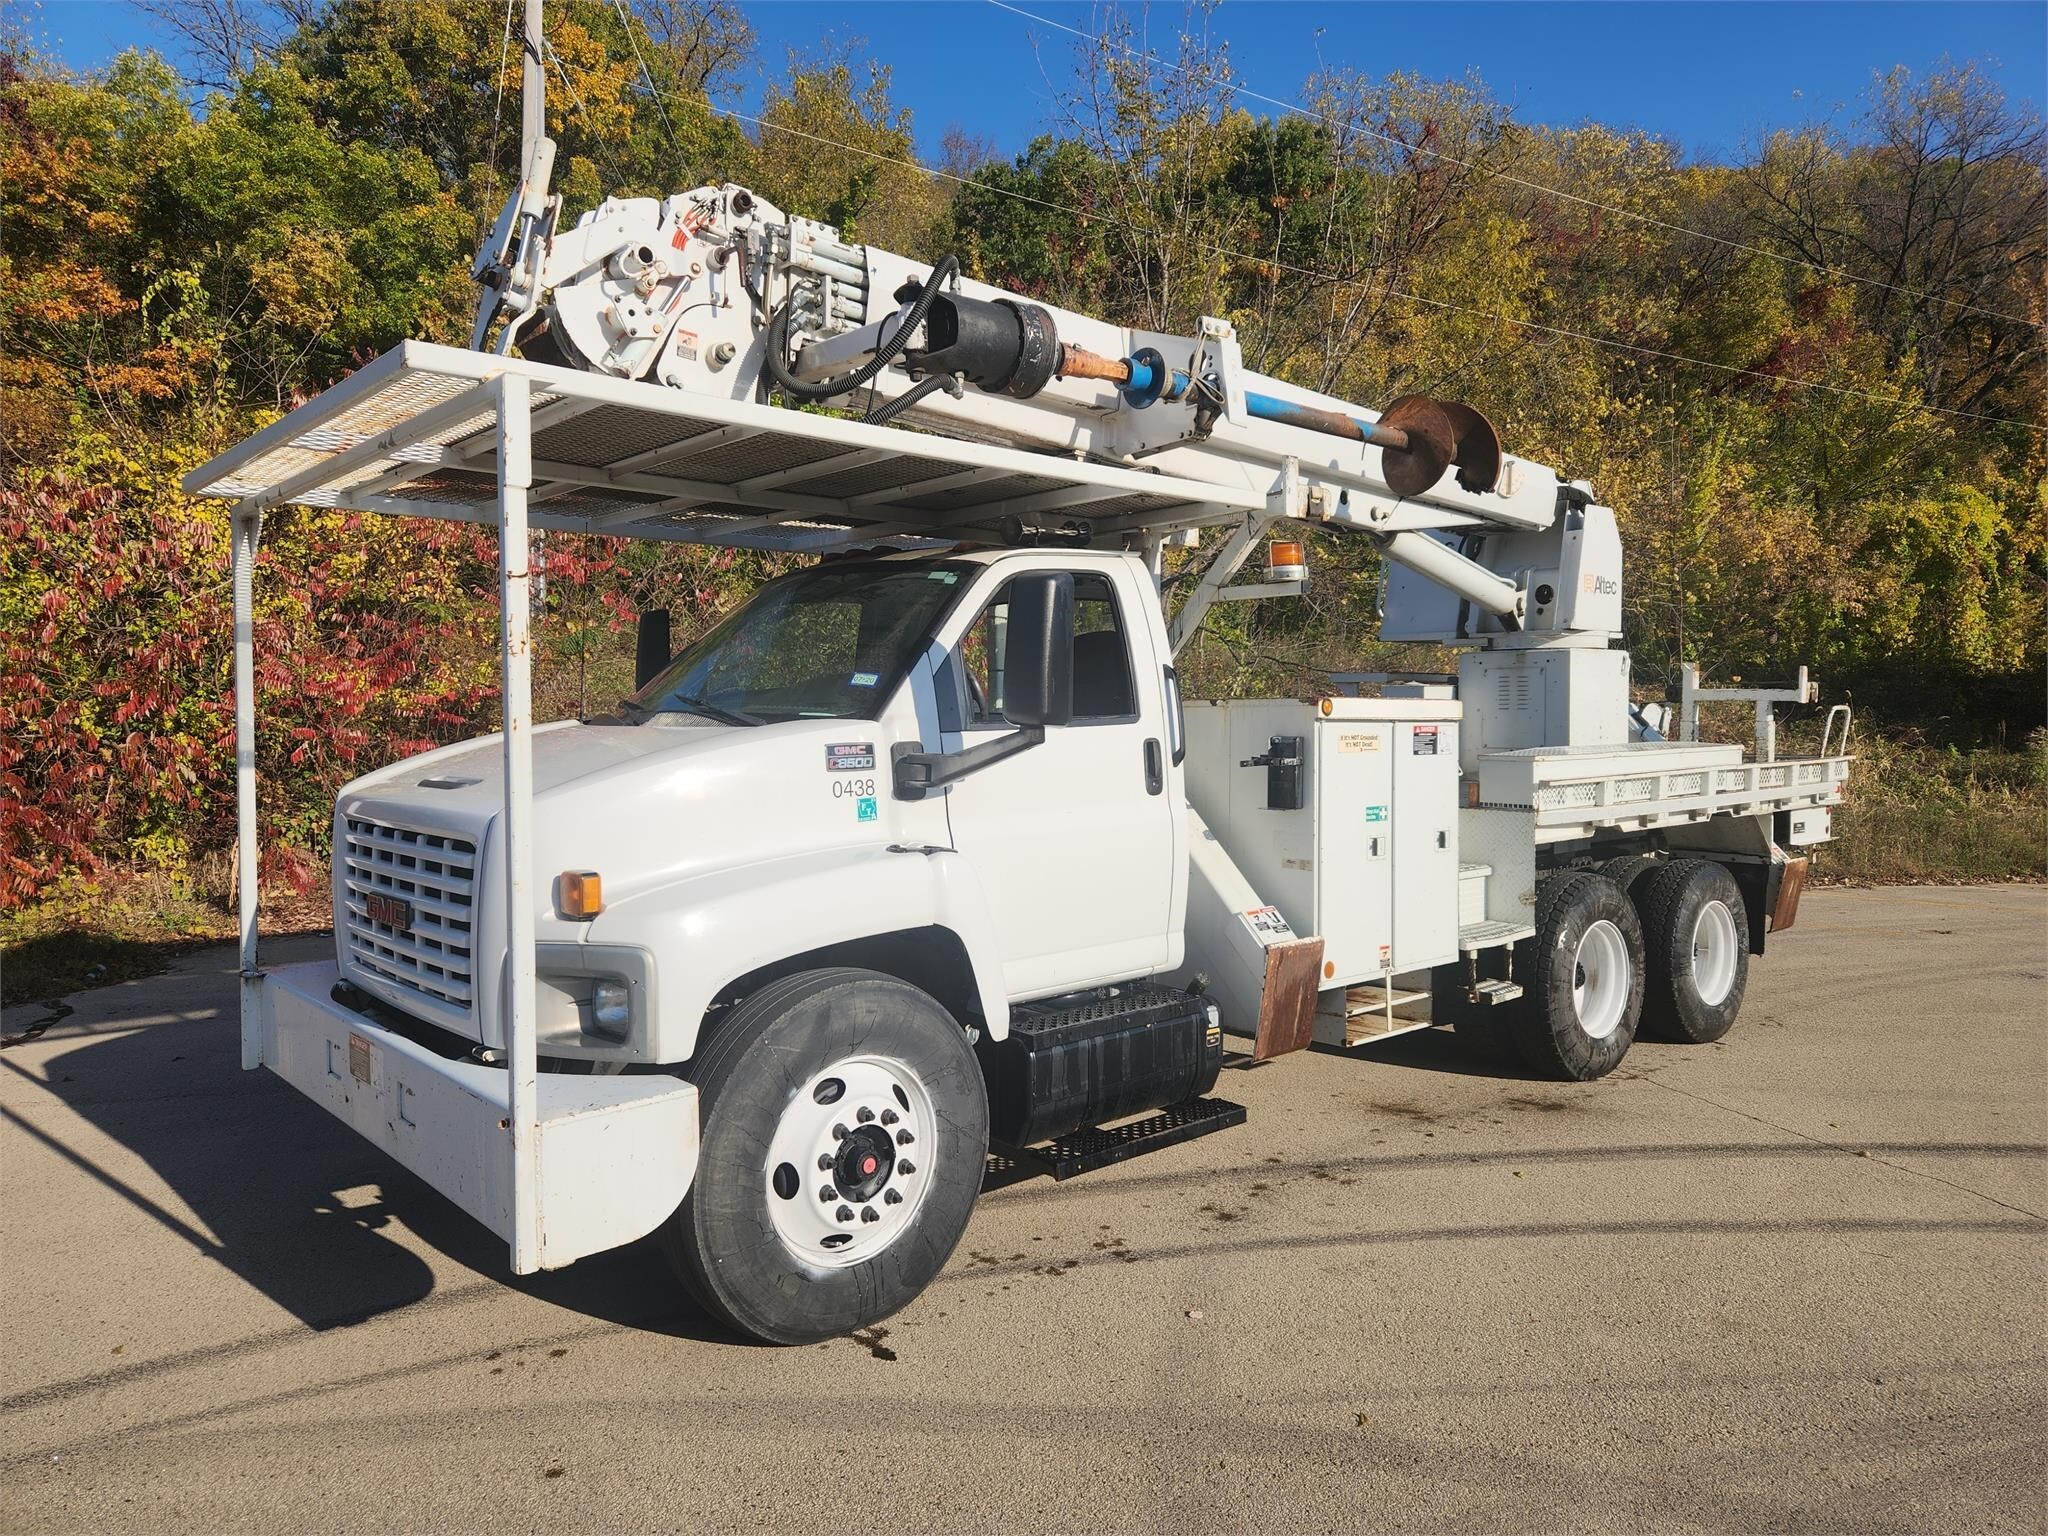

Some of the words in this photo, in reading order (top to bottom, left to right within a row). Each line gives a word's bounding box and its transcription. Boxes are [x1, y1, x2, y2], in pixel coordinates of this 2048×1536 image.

[1594, 576, 1617, 595] Altec
[834, 745, 866, 755] GMC
[829, 757, 873, 769] C8500
[832, 778, 875, 798] 0438
[366, 894, 407, 929] GMC
